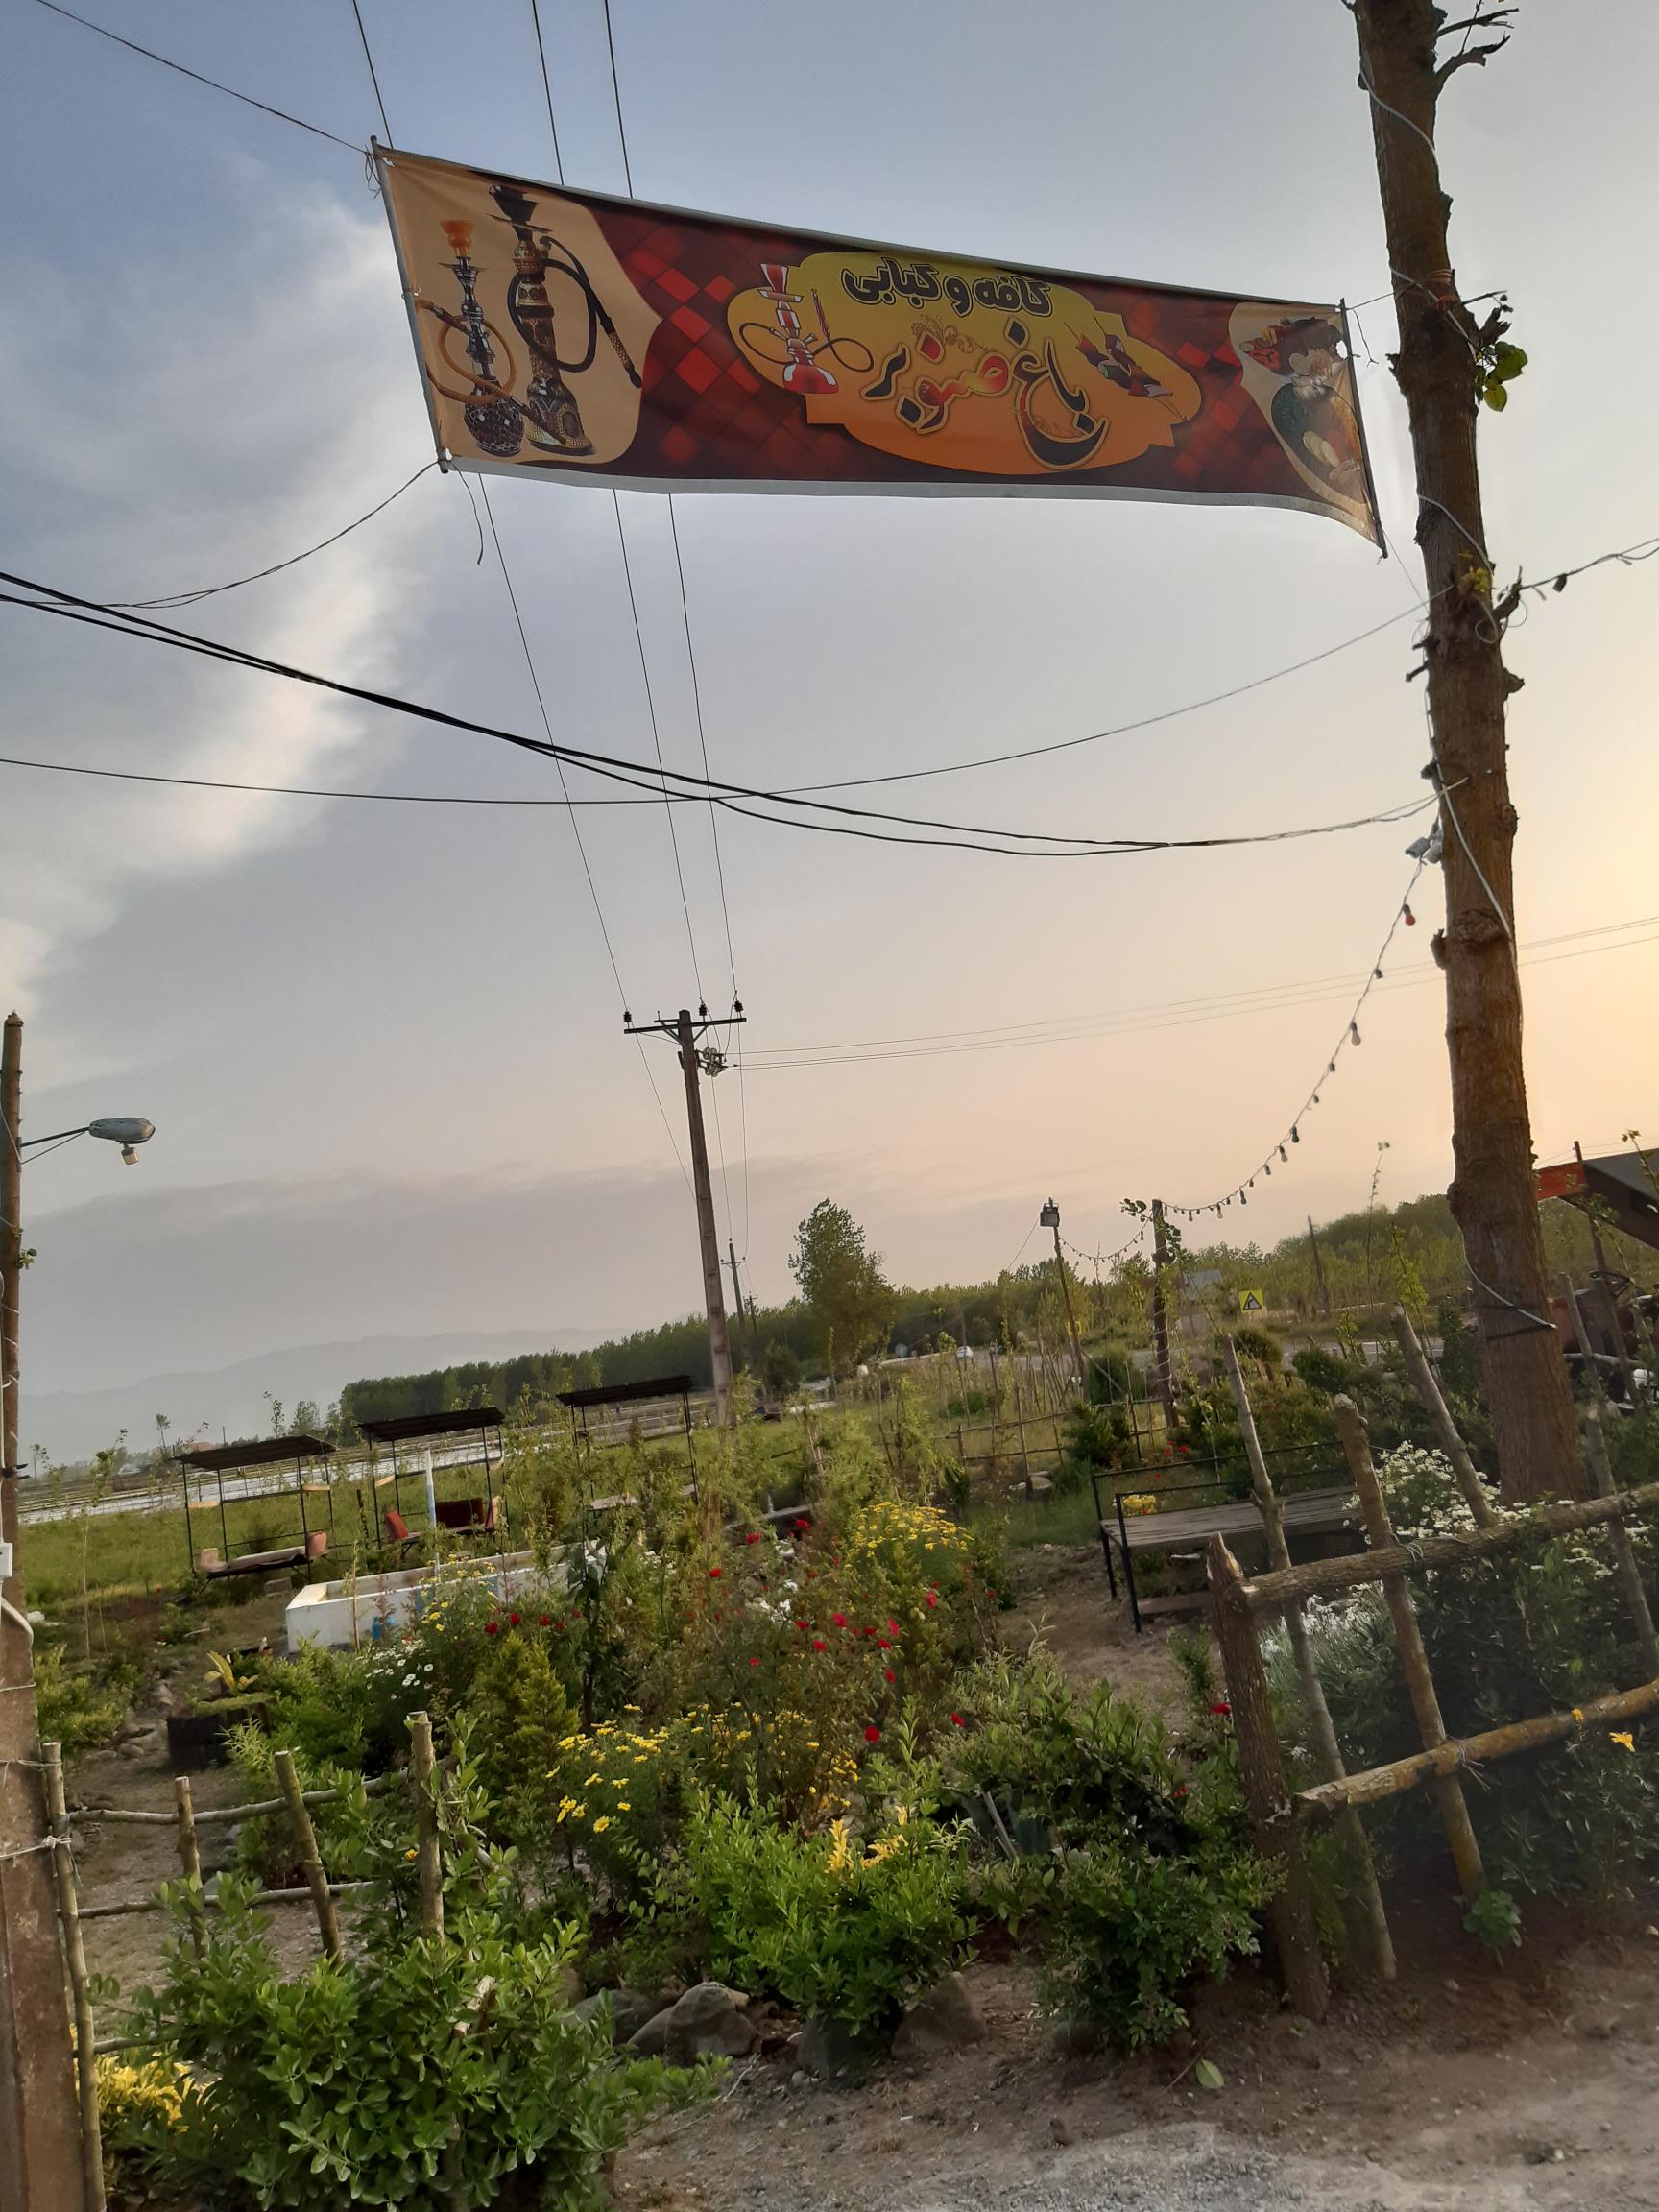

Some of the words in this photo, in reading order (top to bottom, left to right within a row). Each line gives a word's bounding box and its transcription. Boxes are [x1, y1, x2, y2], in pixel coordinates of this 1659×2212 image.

[841, 257, 943, 309] کبابی
[943, 275, 974, 318] و
[973, 275, 1053, 318] کافه
[1008, 316, 1109, 469] باغ
